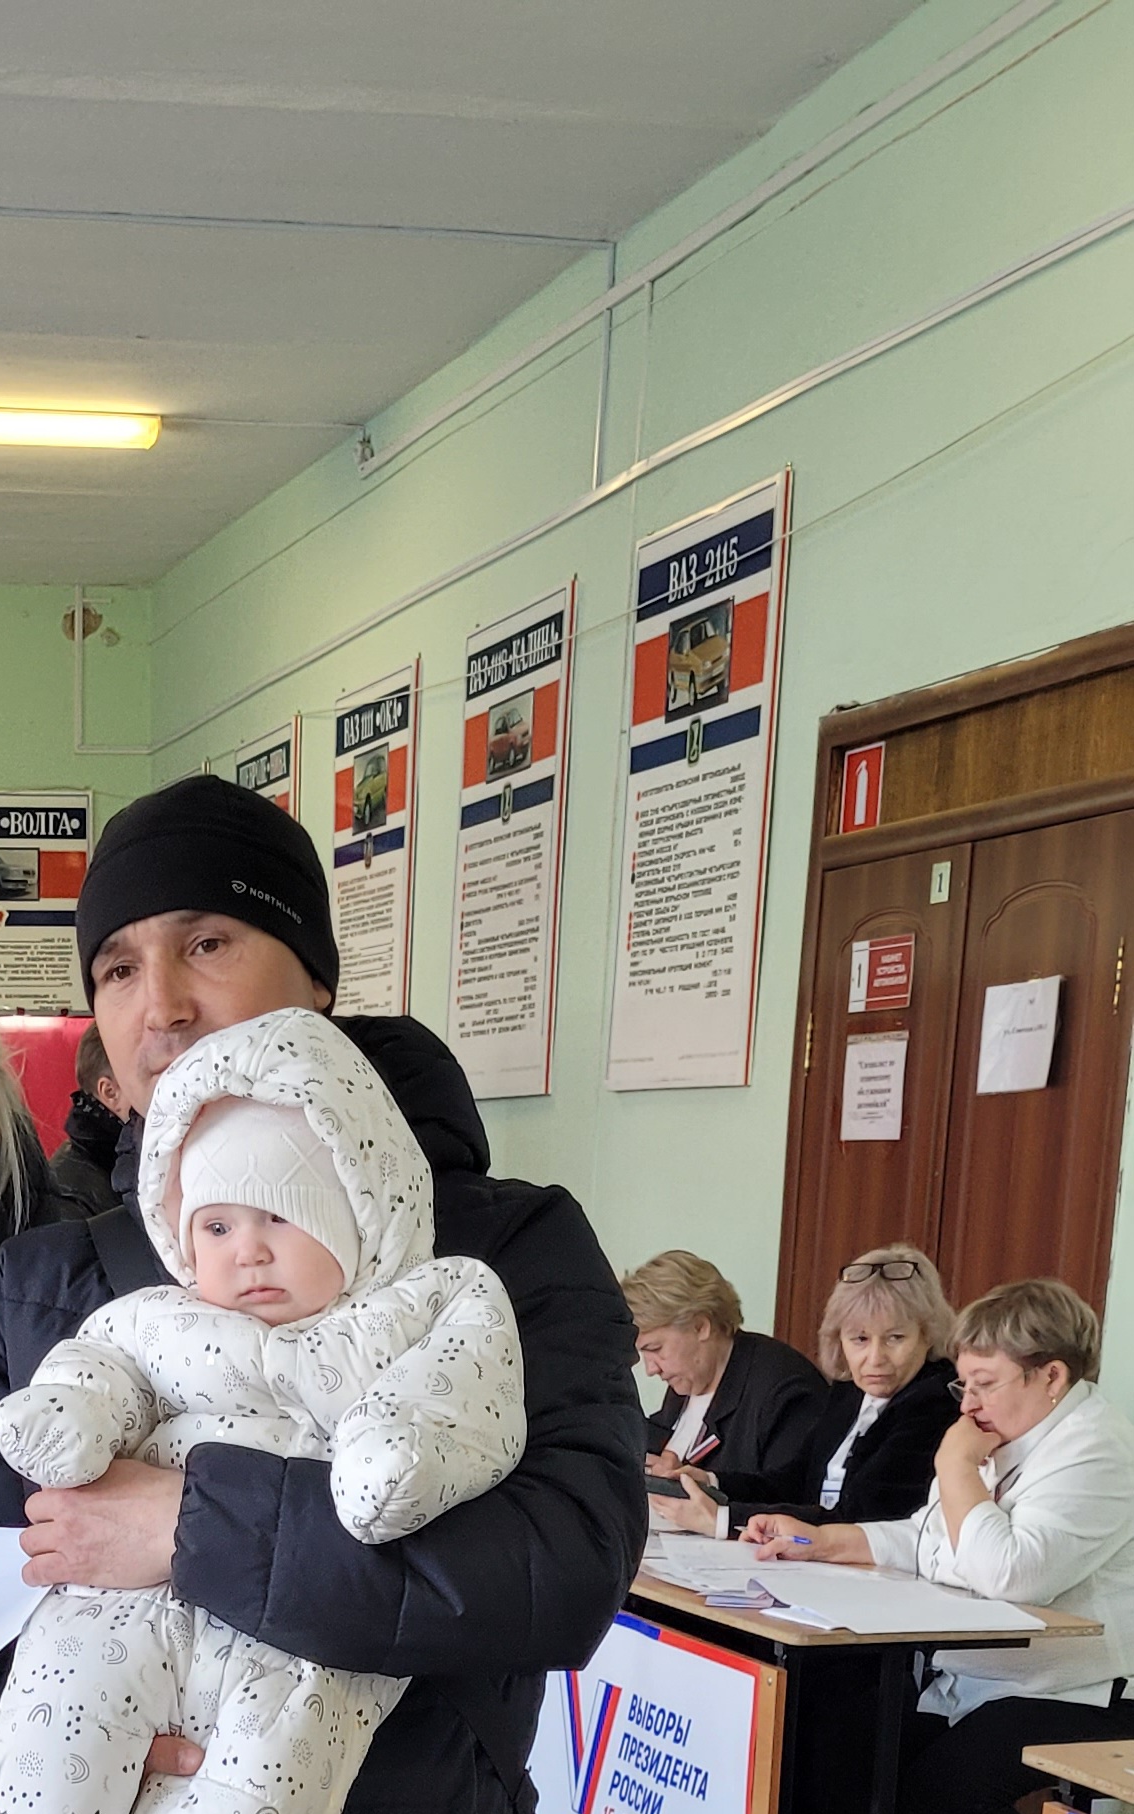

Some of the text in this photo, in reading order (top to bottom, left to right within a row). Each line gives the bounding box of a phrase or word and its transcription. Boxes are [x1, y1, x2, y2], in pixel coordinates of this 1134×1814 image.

[668, 535, 739, 604] ВАЗ 2115
[468, 655, 489, 695] ВАЗ
[343, 713, 360, 749] ВАЗ
[937, 872, 944, 893] 1
[249, 886, 303, 925] NORTHLAND
[627, 1693, 692, 1748] ВЫБОРЫ
[617, 1731, 709, 1801] ПРЕЗИДЕНТА
